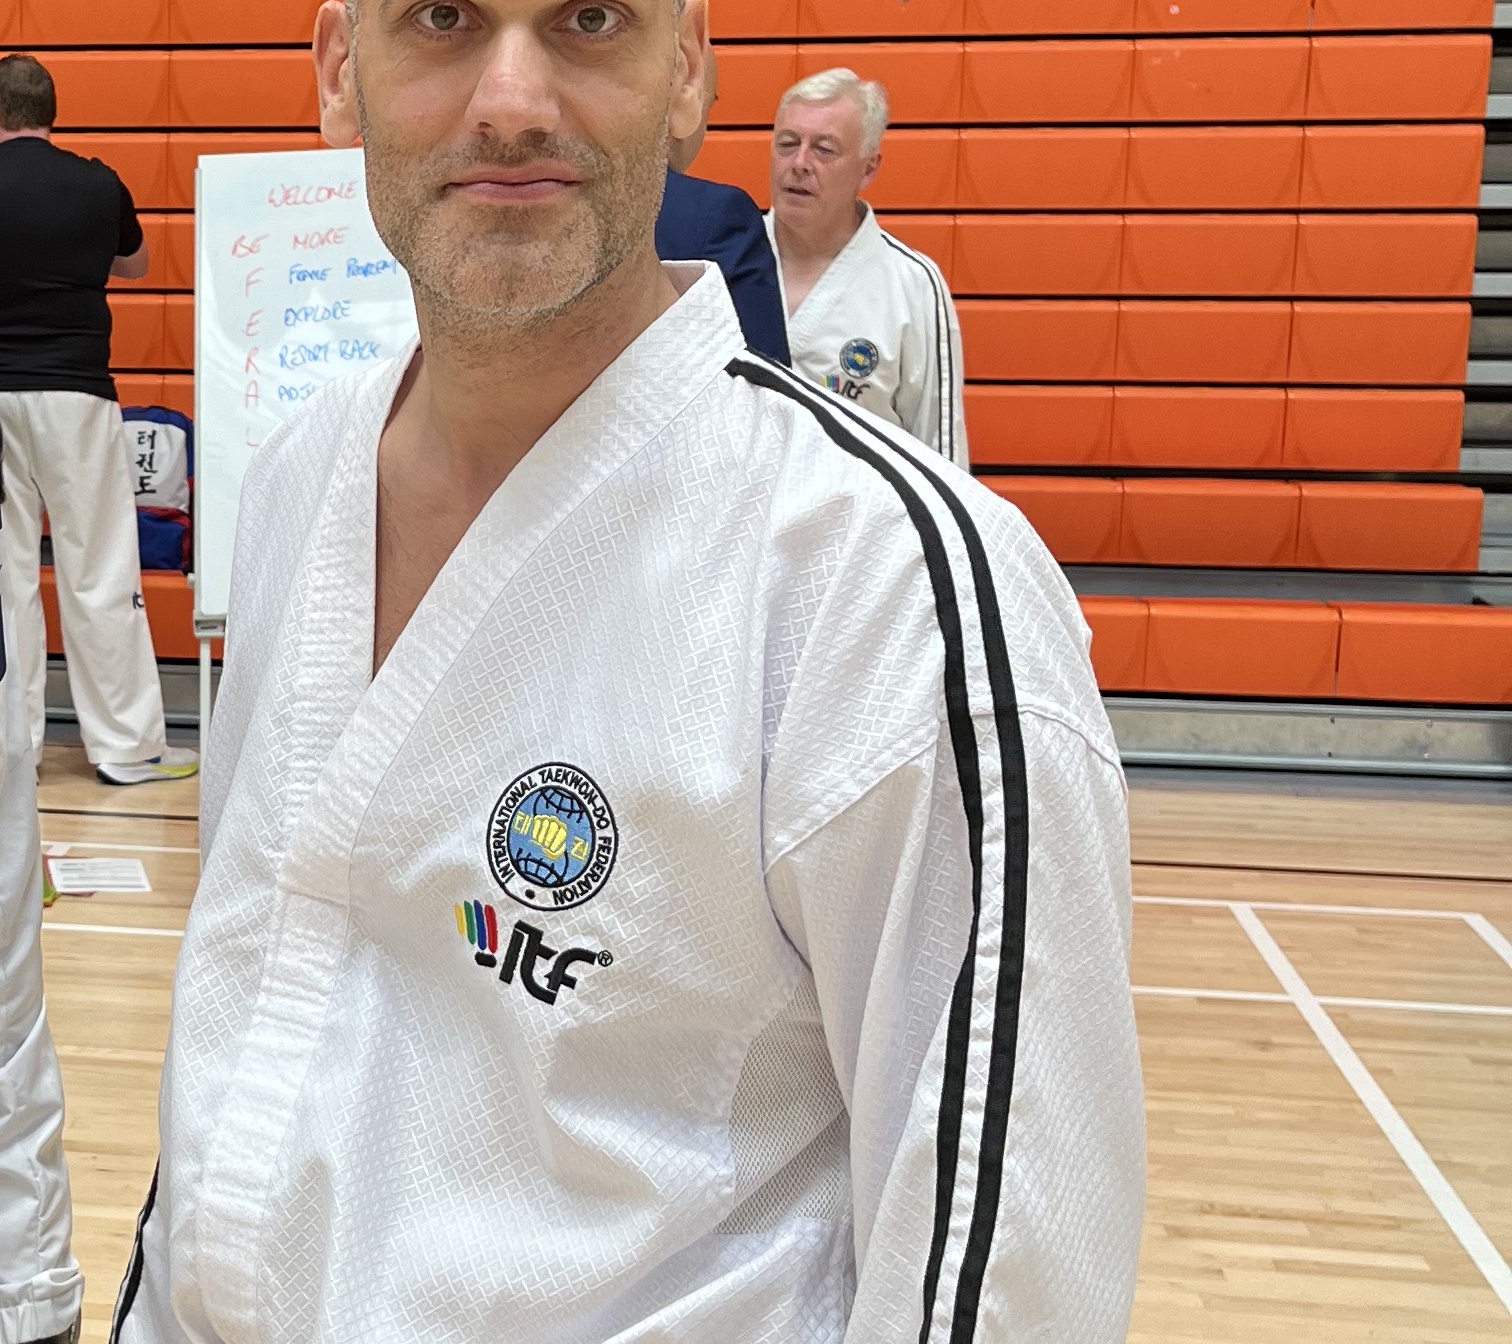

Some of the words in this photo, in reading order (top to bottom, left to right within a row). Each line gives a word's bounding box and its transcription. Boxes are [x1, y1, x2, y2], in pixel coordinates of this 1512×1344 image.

[492, 776, 538, 884] INTERNATIONAL
[538, 768, 610, 830] TAEKWON-DO
[552, 836, 613, 906] FEDERATION
